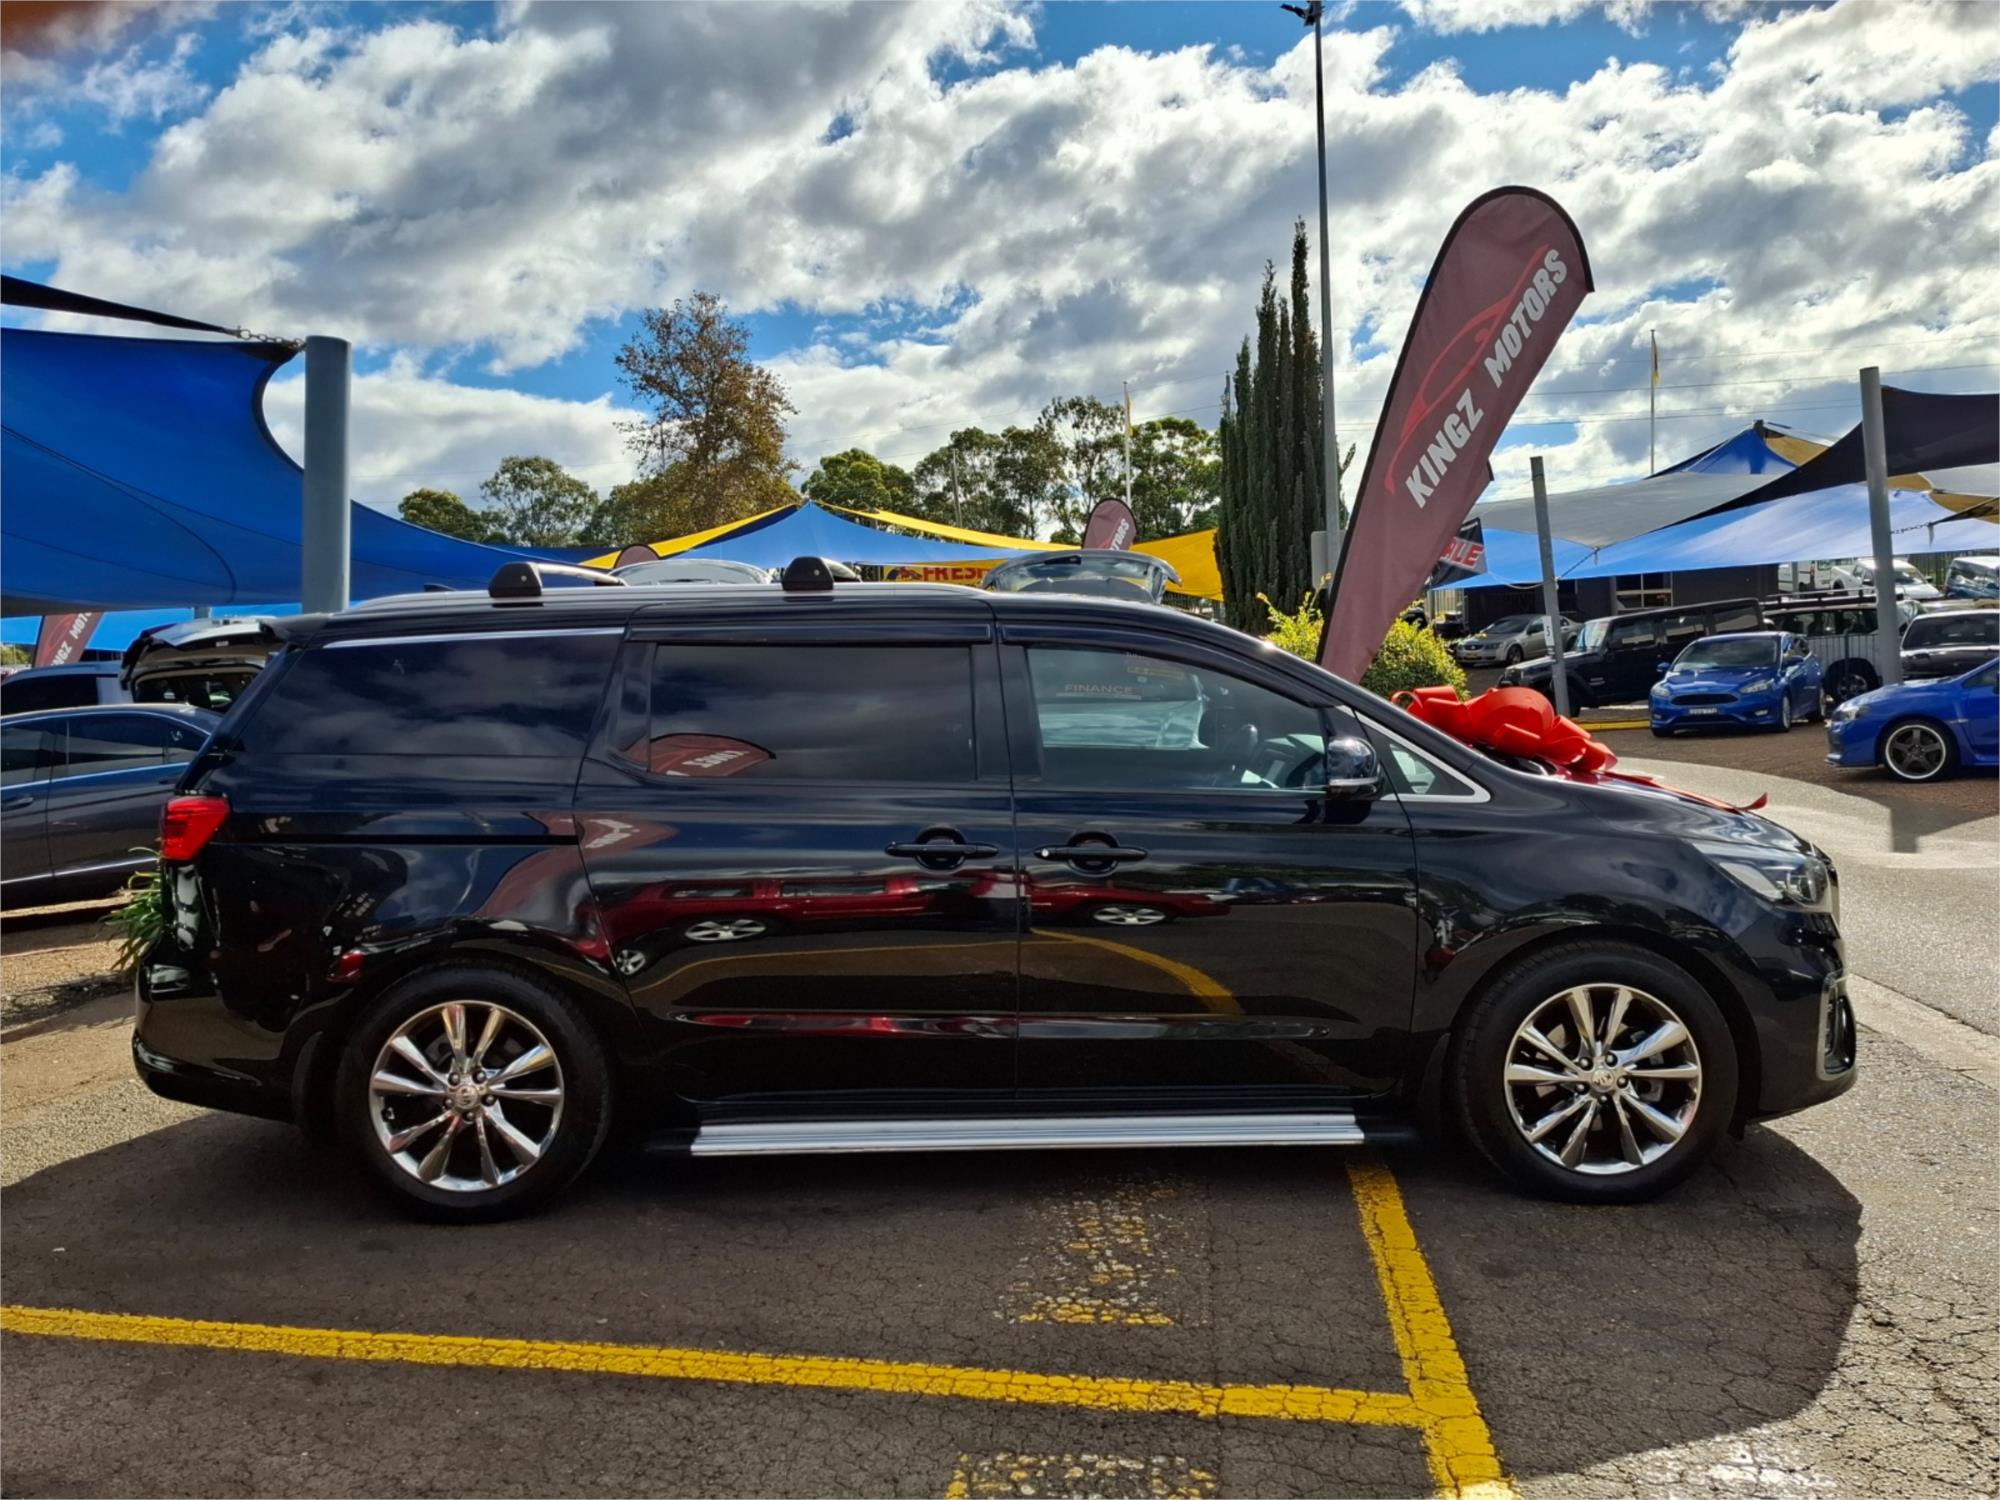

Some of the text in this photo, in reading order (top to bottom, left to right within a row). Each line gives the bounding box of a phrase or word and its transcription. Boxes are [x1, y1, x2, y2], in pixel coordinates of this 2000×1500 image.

[1405, 249, 1568, 508] KINGZ MOTORS
[1109, 518, 1130, 550] TORS
[51, 612, 92, 666] NGZ MOT
[1063, 683, 1135, 695] FINANCE
